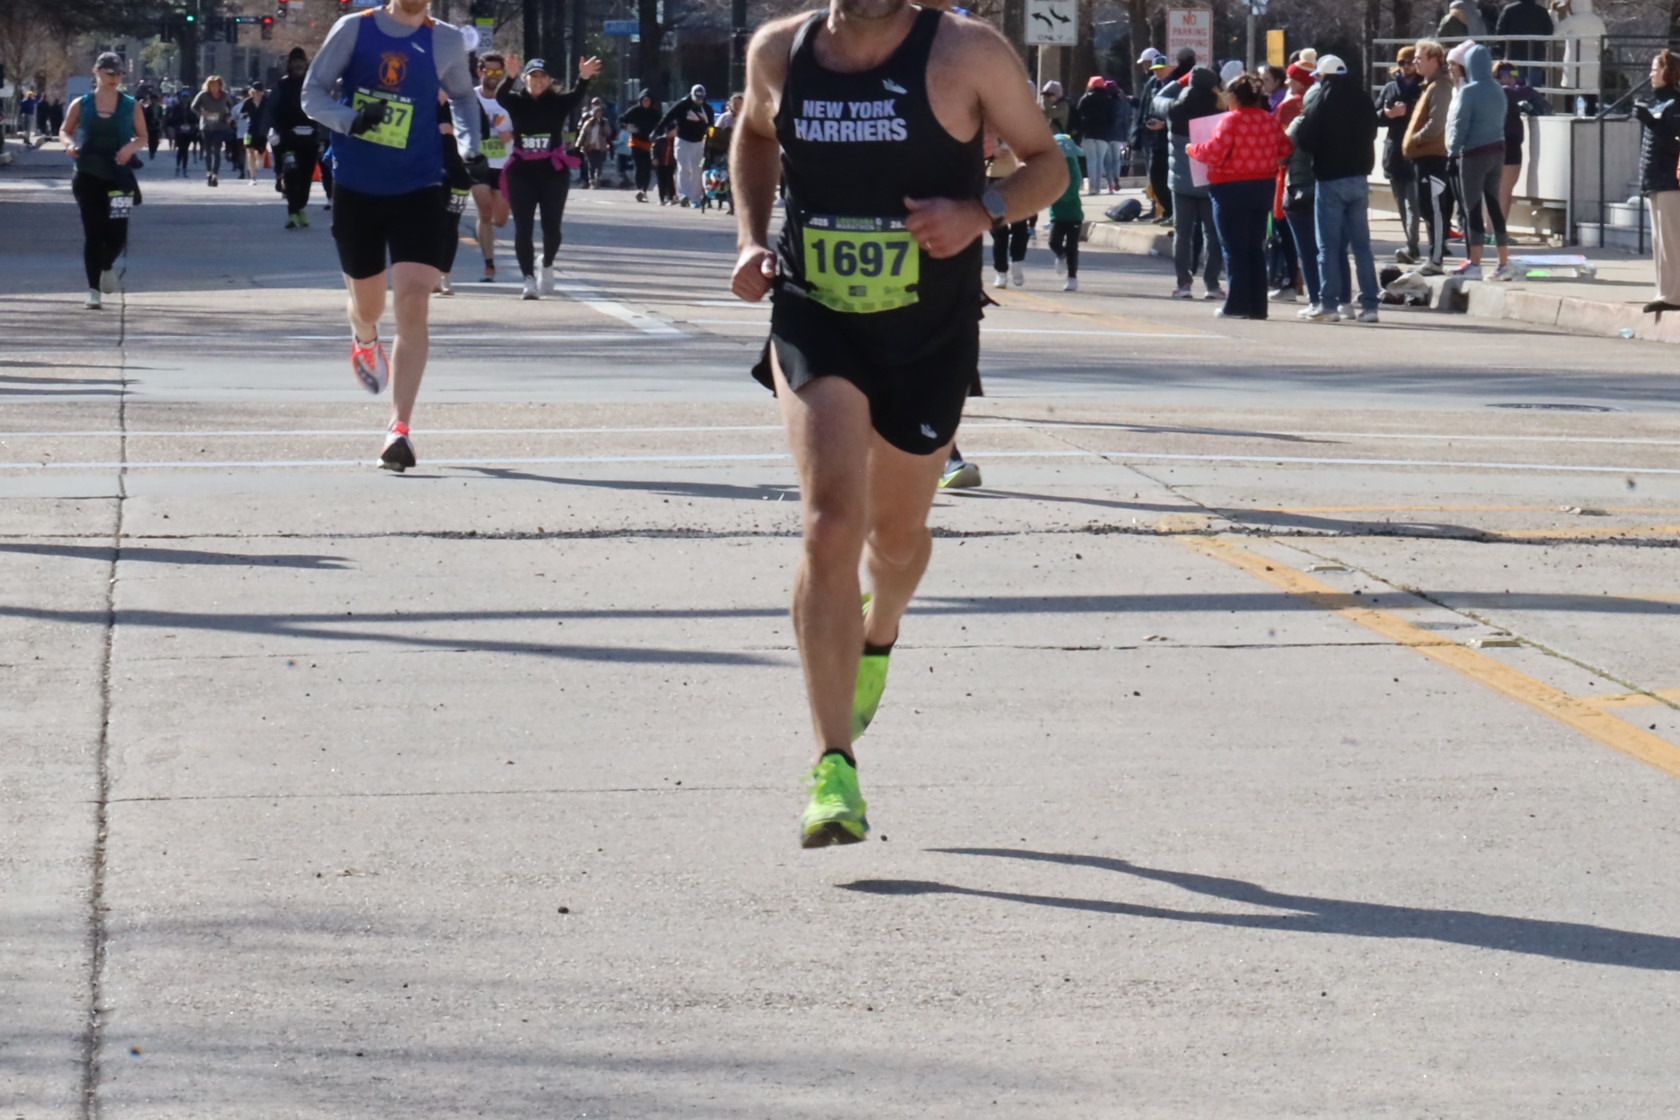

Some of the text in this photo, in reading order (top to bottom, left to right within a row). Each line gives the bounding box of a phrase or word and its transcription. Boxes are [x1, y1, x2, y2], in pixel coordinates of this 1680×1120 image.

[1183, 14, 1197, 25] NO
[1172, 27, 1208, 37] PARKING
[356, 98, 408, 127] 287
[803, 99, 896, 119] NEW YORK
[794, 118, 908, 142] HARRIERS
[521, 137, 550, 149] 3817
[890, 220, 907, 229] 26.
[811, 238, 910, 277] 1697
